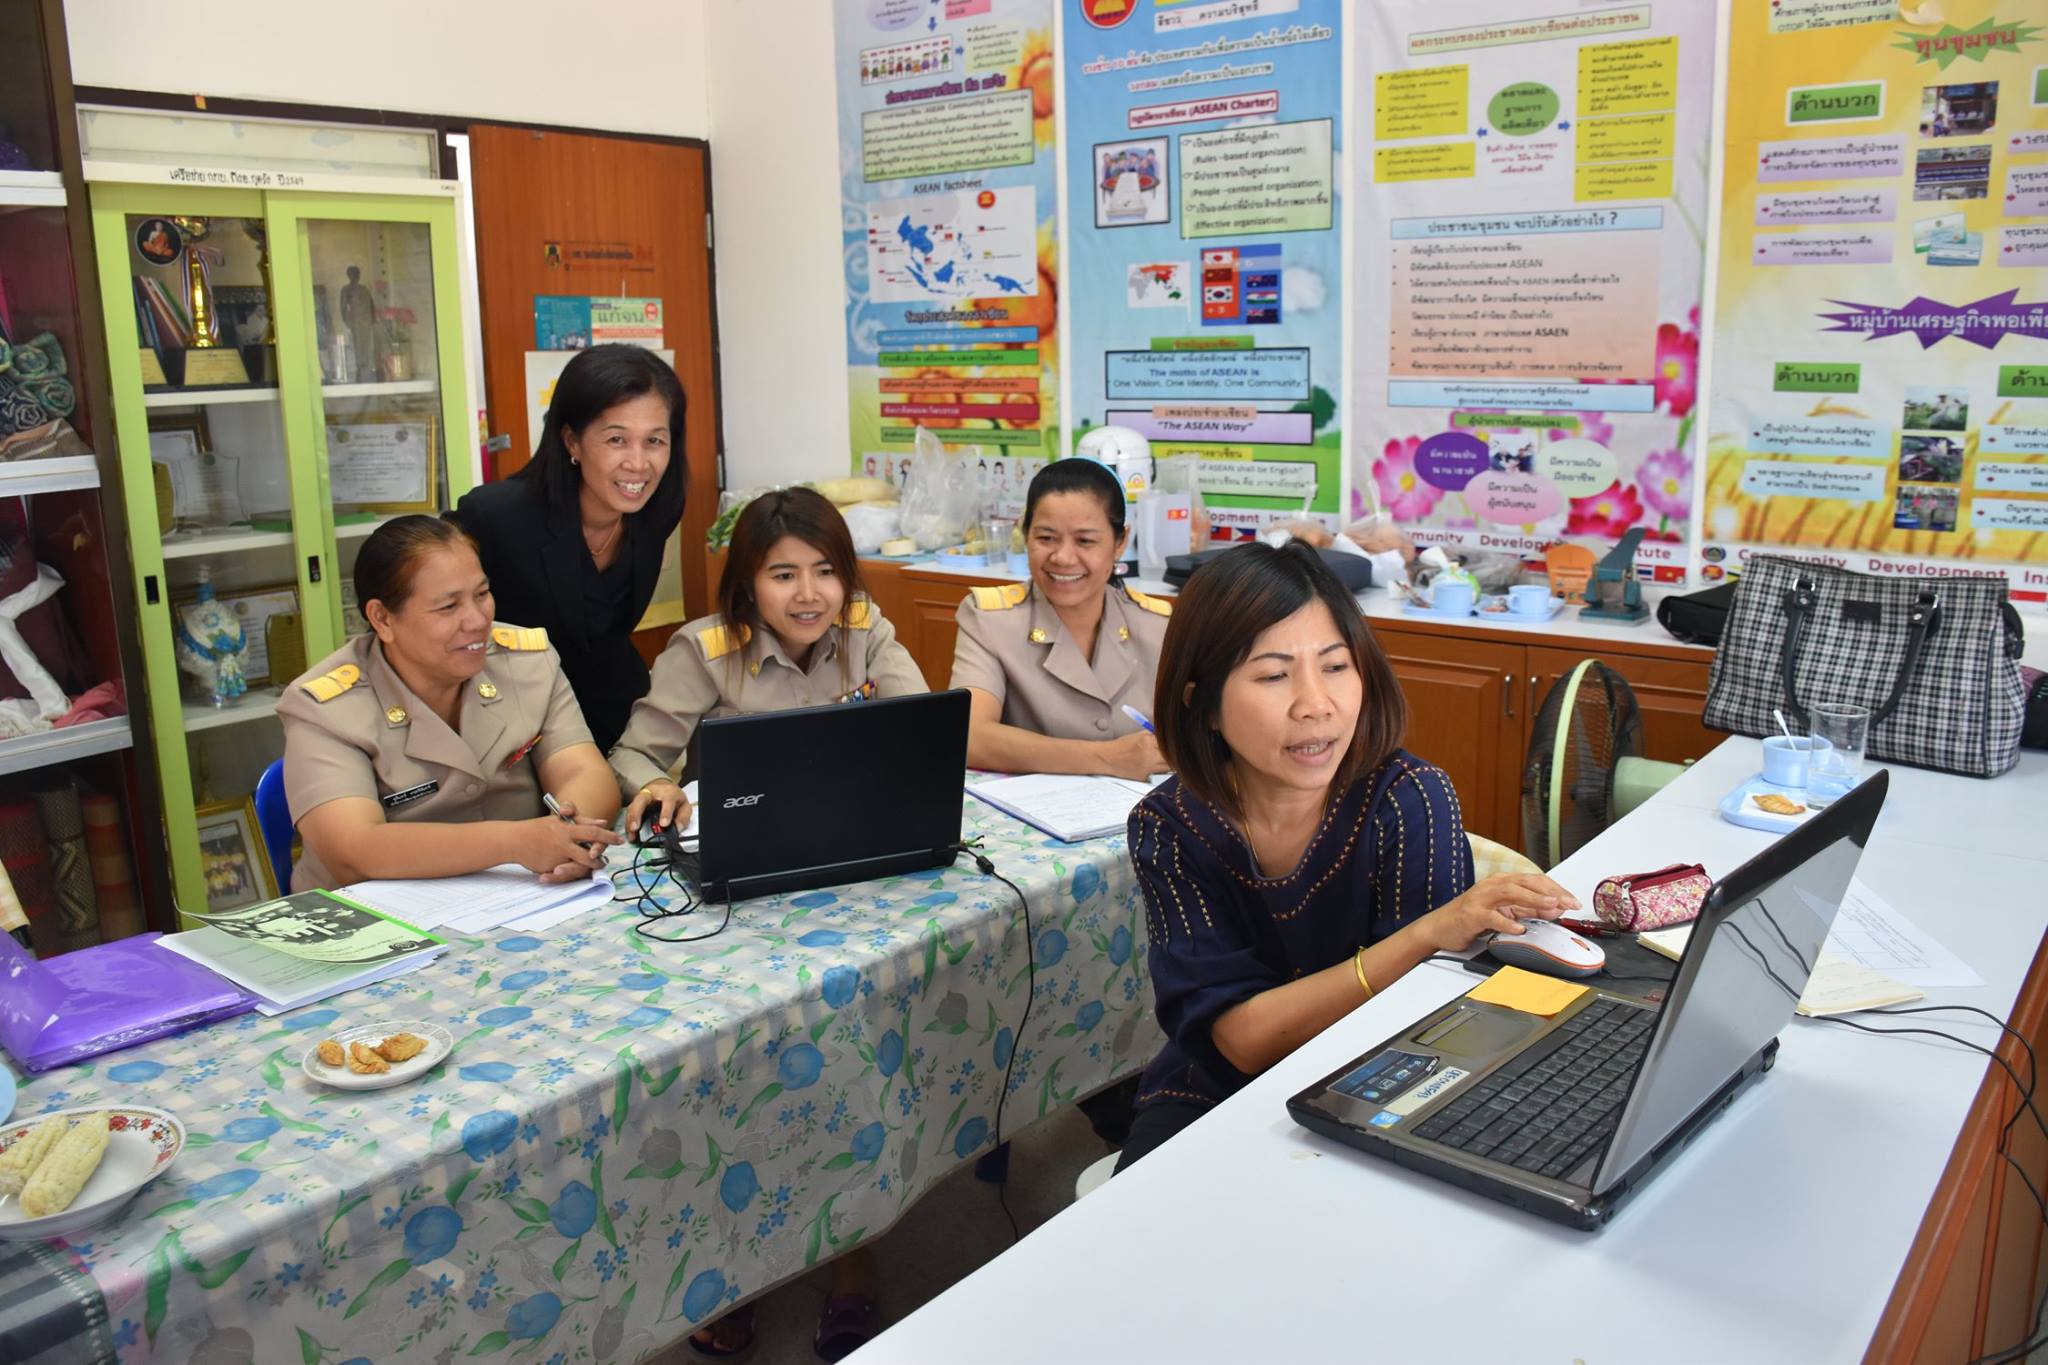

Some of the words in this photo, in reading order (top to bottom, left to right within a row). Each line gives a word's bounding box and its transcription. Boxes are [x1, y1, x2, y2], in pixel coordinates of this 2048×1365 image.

[1793, 90, 1877, 112] ด้านบวก
[1211, 368, 1248, 377] ASEAN
[1777, 365, 1856, 384] ด้านบวก
[1184, 421, 1220, 431] ASEAN
[723, 794, 765, 808] acer
